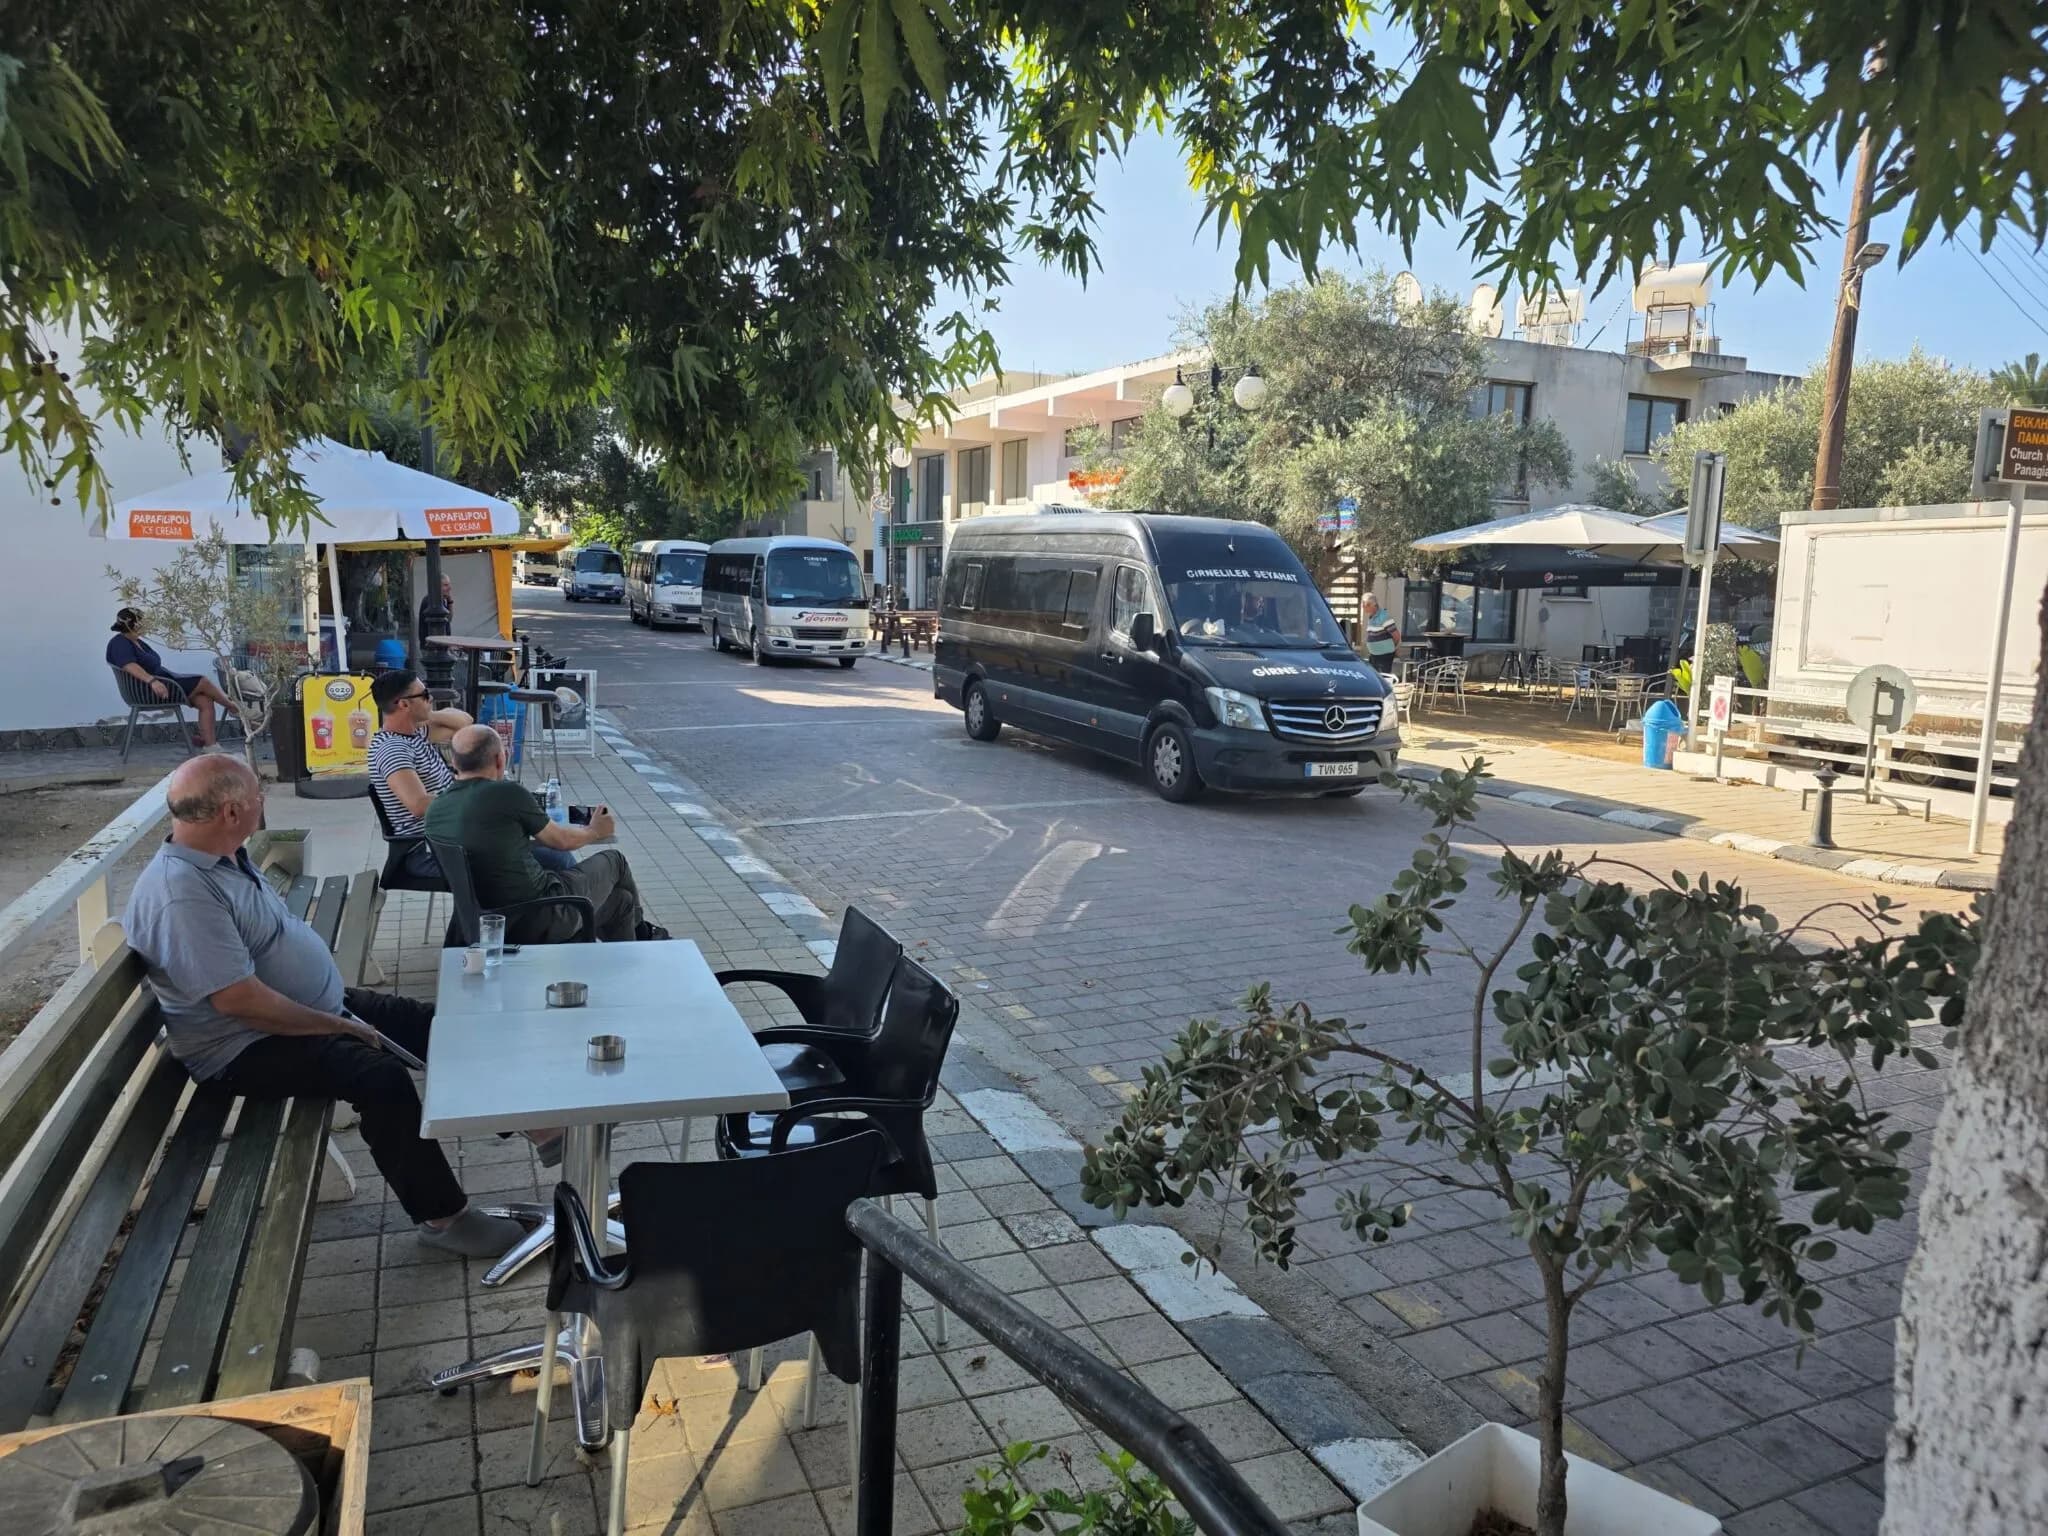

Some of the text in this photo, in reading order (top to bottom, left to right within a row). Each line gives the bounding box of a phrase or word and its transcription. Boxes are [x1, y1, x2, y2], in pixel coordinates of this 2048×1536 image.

[2018, 431, 2048, 446] ΠΑΝΑ
[2010, 447, 2043, 461] Church
[134, 514, 190, 525] PAPAFILIPOU
[428, 511, 488, 522] PAPAFILIPOU
[155, 526, 182, 536] CREAM
[454, 521, 481, 532] CREAM
[1253, 570, 1298, 583] SEYAHAT
[1318, 764, 1353, 775] TVN 965
